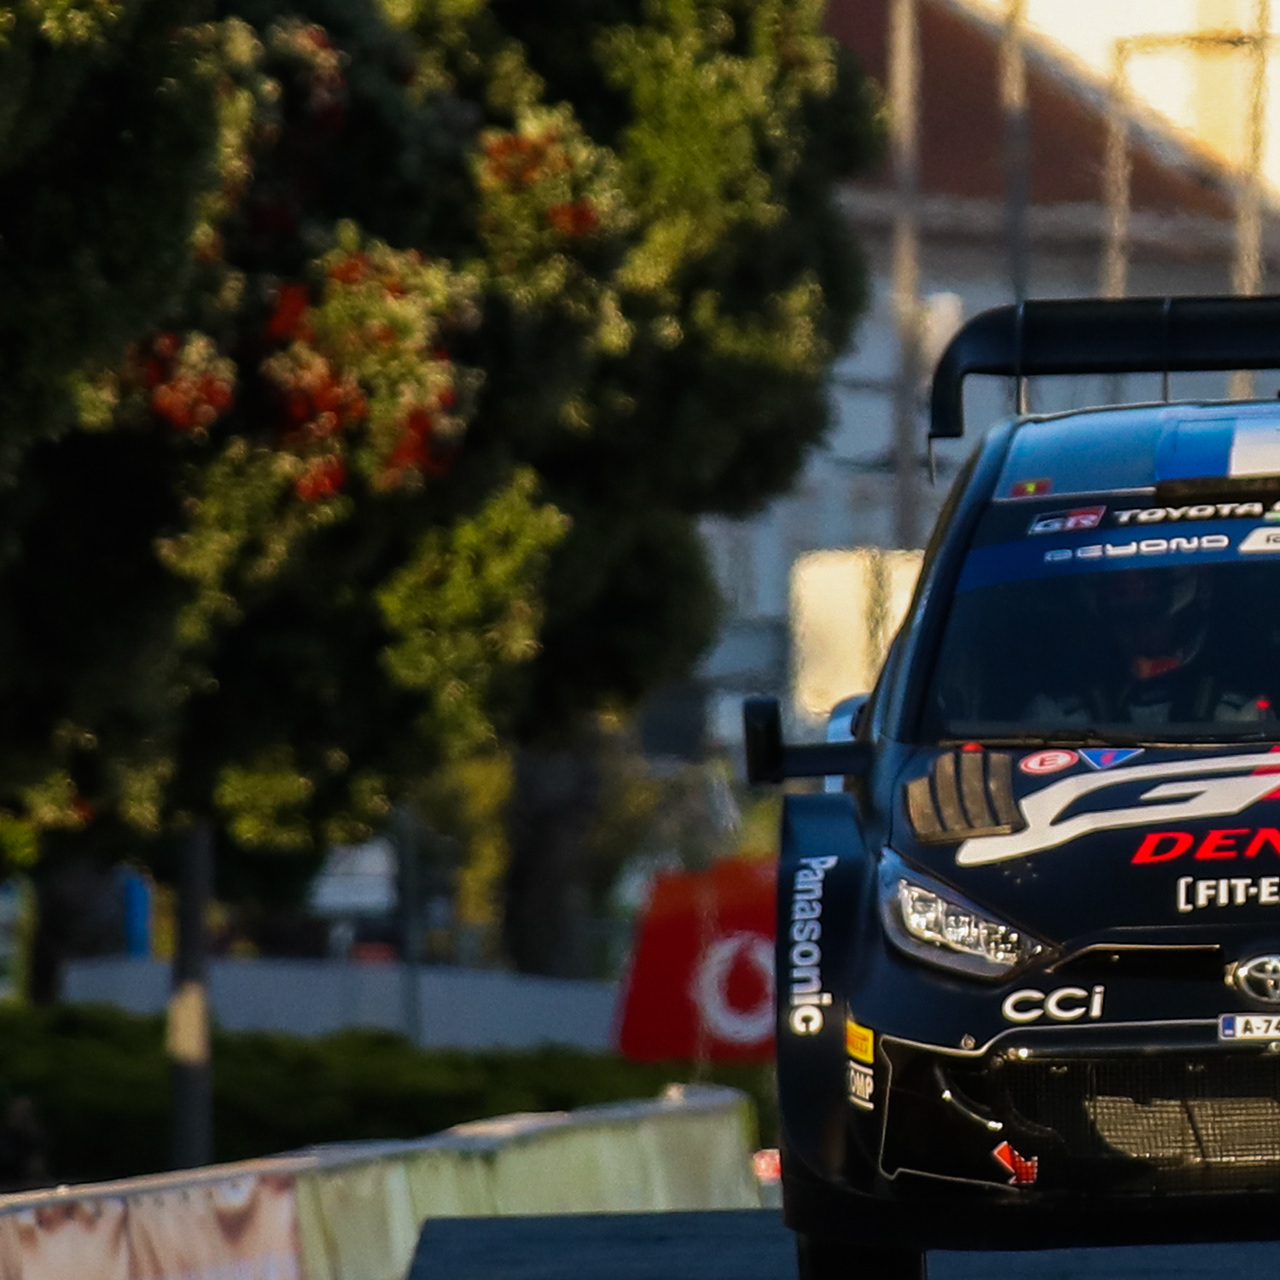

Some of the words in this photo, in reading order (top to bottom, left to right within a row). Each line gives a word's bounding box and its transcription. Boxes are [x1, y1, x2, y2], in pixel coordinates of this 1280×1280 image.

[1113, 502, 1263, 523] TOYOTA
[1044, 534, 1229, 562] BEYOND
[789, 855, 839, 1036] Panasonic
